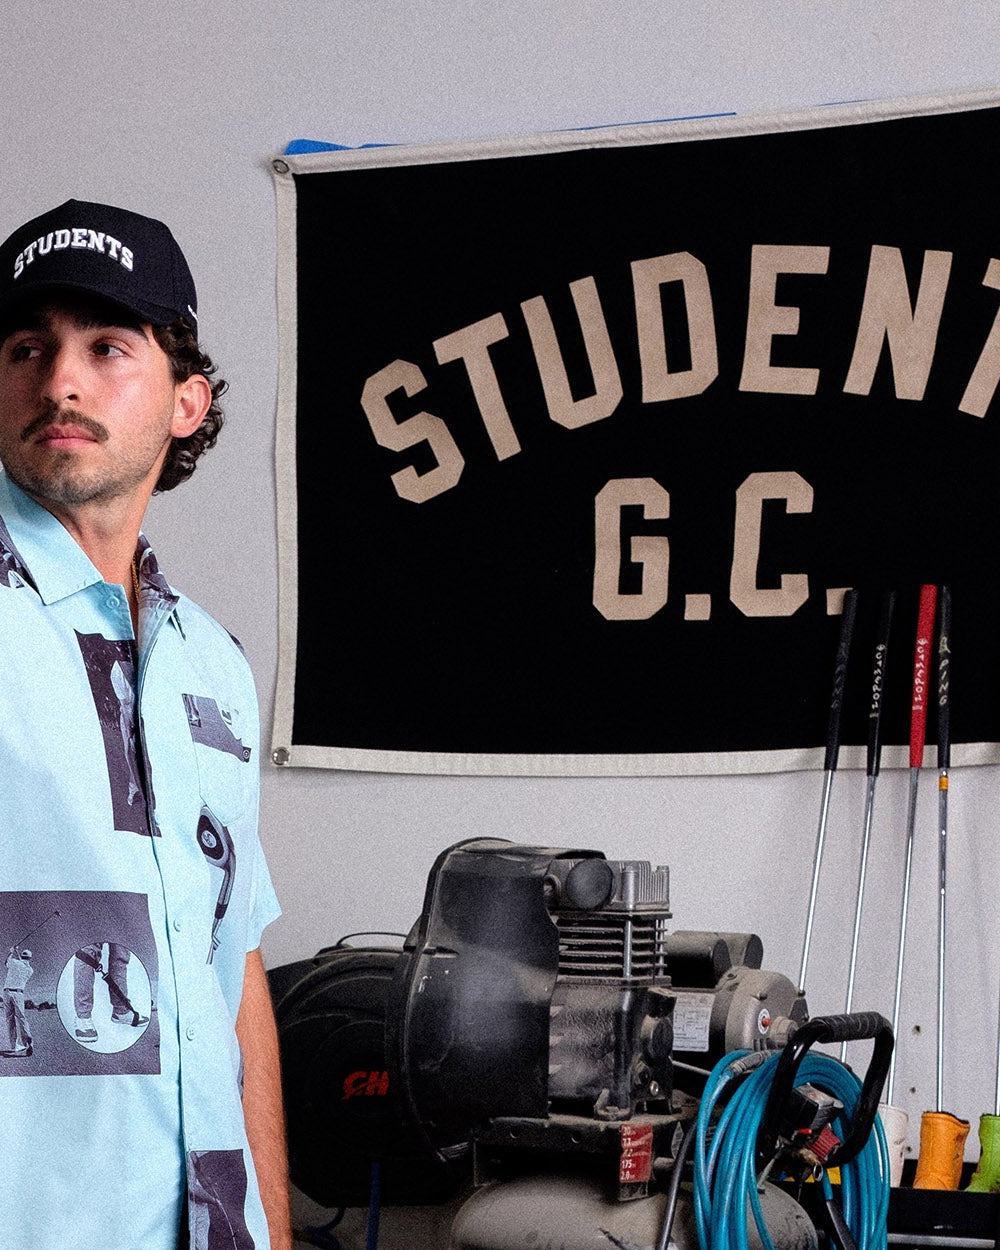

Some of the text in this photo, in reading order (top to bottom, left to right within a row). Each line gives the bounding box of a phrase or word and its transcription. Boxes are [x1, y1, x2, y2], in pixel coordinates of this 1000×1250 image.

[13, 227, 135, 280] STUDENTS
[592, 470, 853, 621] G.C.
[938, 658, 950, 706] PING
